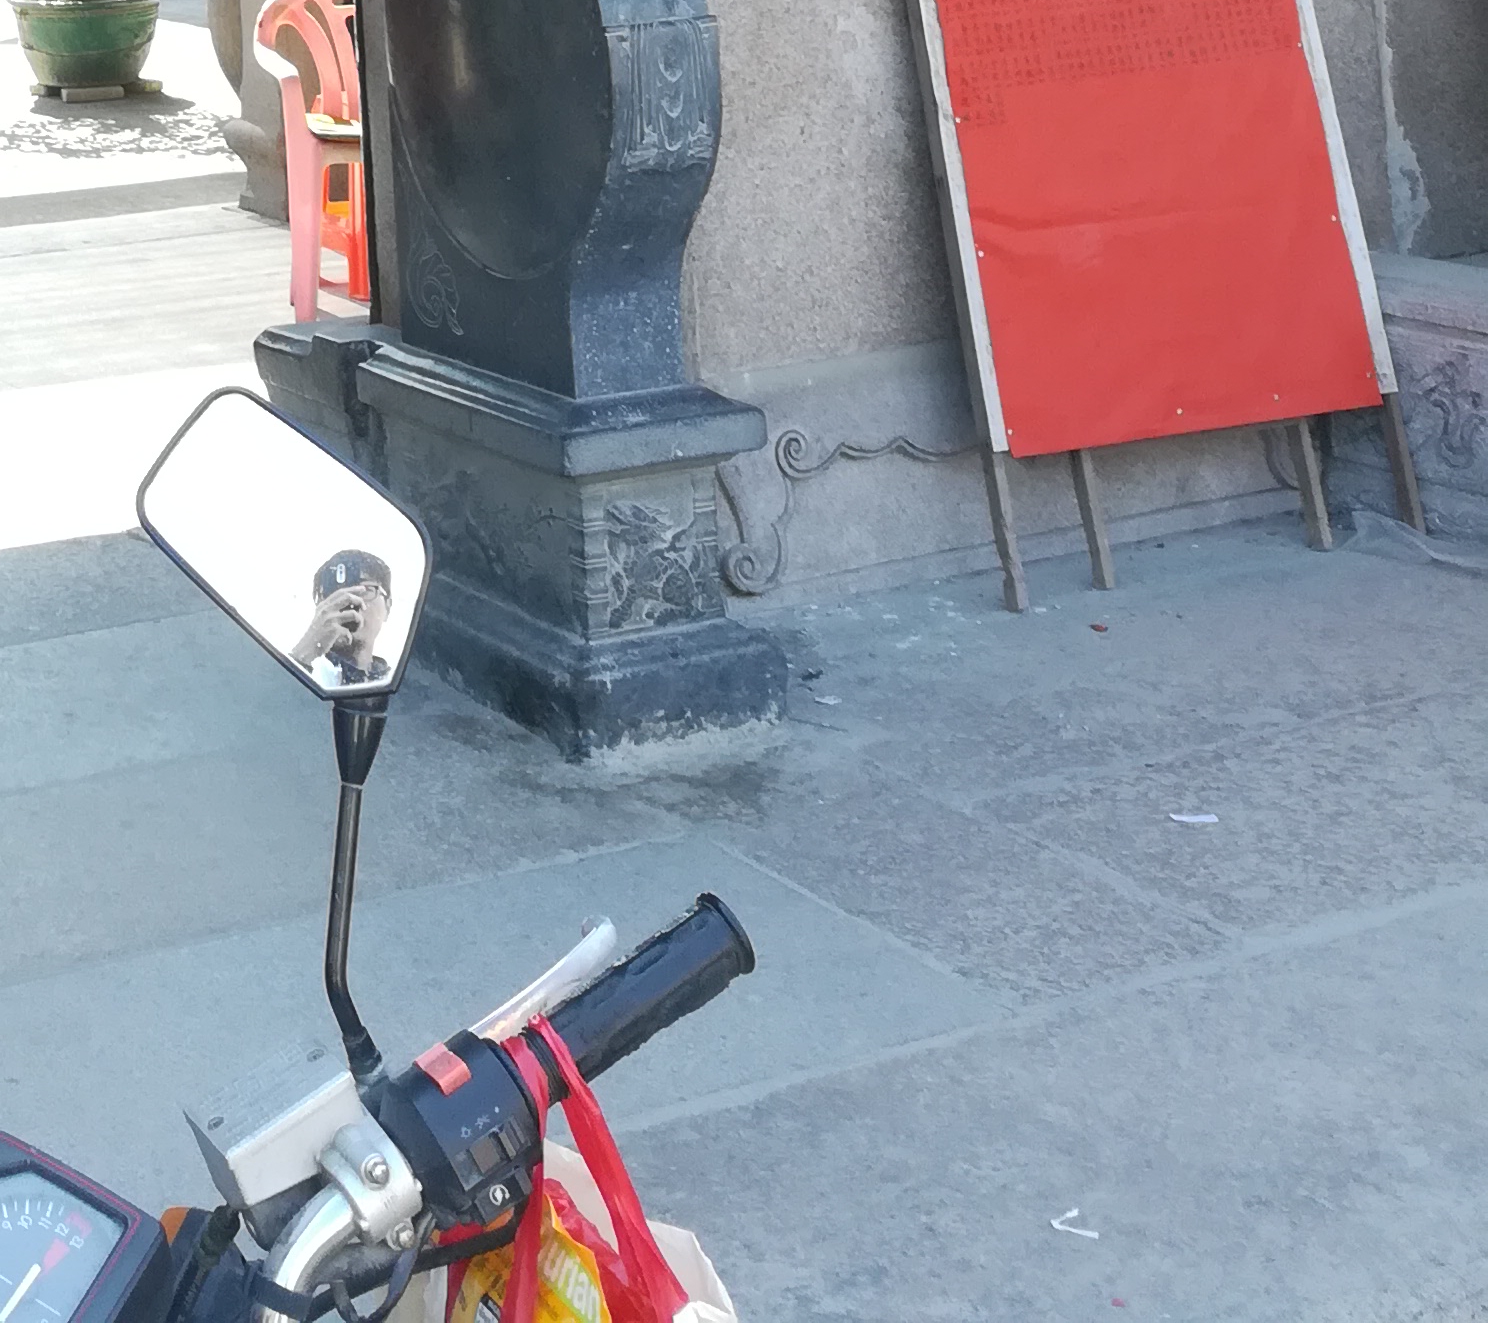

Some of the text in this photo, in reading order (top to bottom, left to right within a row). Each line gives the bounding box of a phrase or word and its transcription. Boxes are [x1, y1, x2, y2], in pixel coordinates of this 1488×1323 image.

[1, 1220, 13, 1231] 9
[17, 1215, 33, 1230] 10
[38, 1216, 52, 1230] 11
[54, 1222, 70, 1237] 12
[68, 1235, 85, 1249] 13
